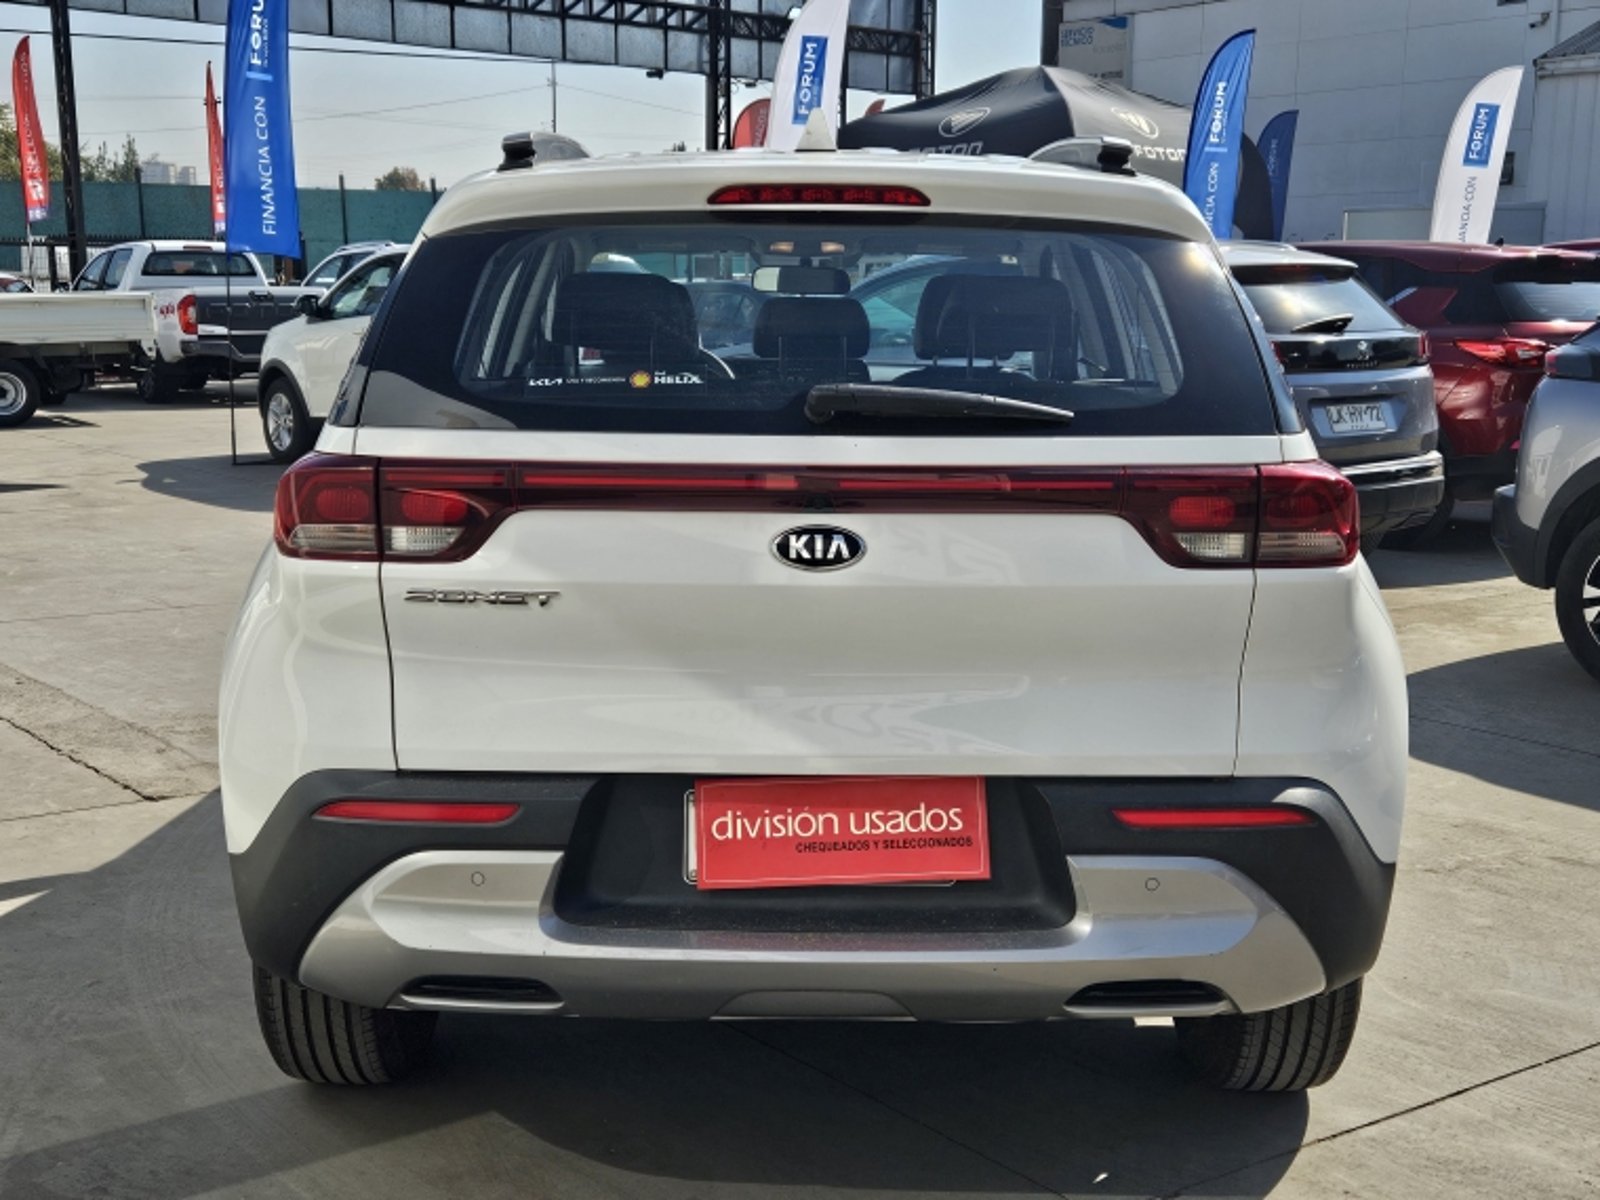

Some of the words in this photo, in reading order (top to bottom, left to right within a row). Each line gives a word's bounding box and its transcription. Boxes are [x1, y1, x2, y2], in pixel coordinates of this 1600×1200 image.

[797, 42, 818, 116] FORUM
[254, 95, 267, 142] CON
[1209, 81, 1228, 143] FORUM
[1468, 107, 1490, 160] FORUM
[258, 145, 277, 236] FINANCIA
[1208, 161, 1220, 193] CON
[1464, 175, 1478, 200] CON
[654, 371, 705, 385] HELIX
[787, 534, 851, 560] KIA
[403, 588, 561, 608] SONET
[711, 807, 839, 840] división
[849, 802, 964, 835] usados
[795, 840, 870, 854] CHEQUEADOS
[873, 839, 881, 850] Y
[881, 835, 974, 850] SELECCIONADOS
